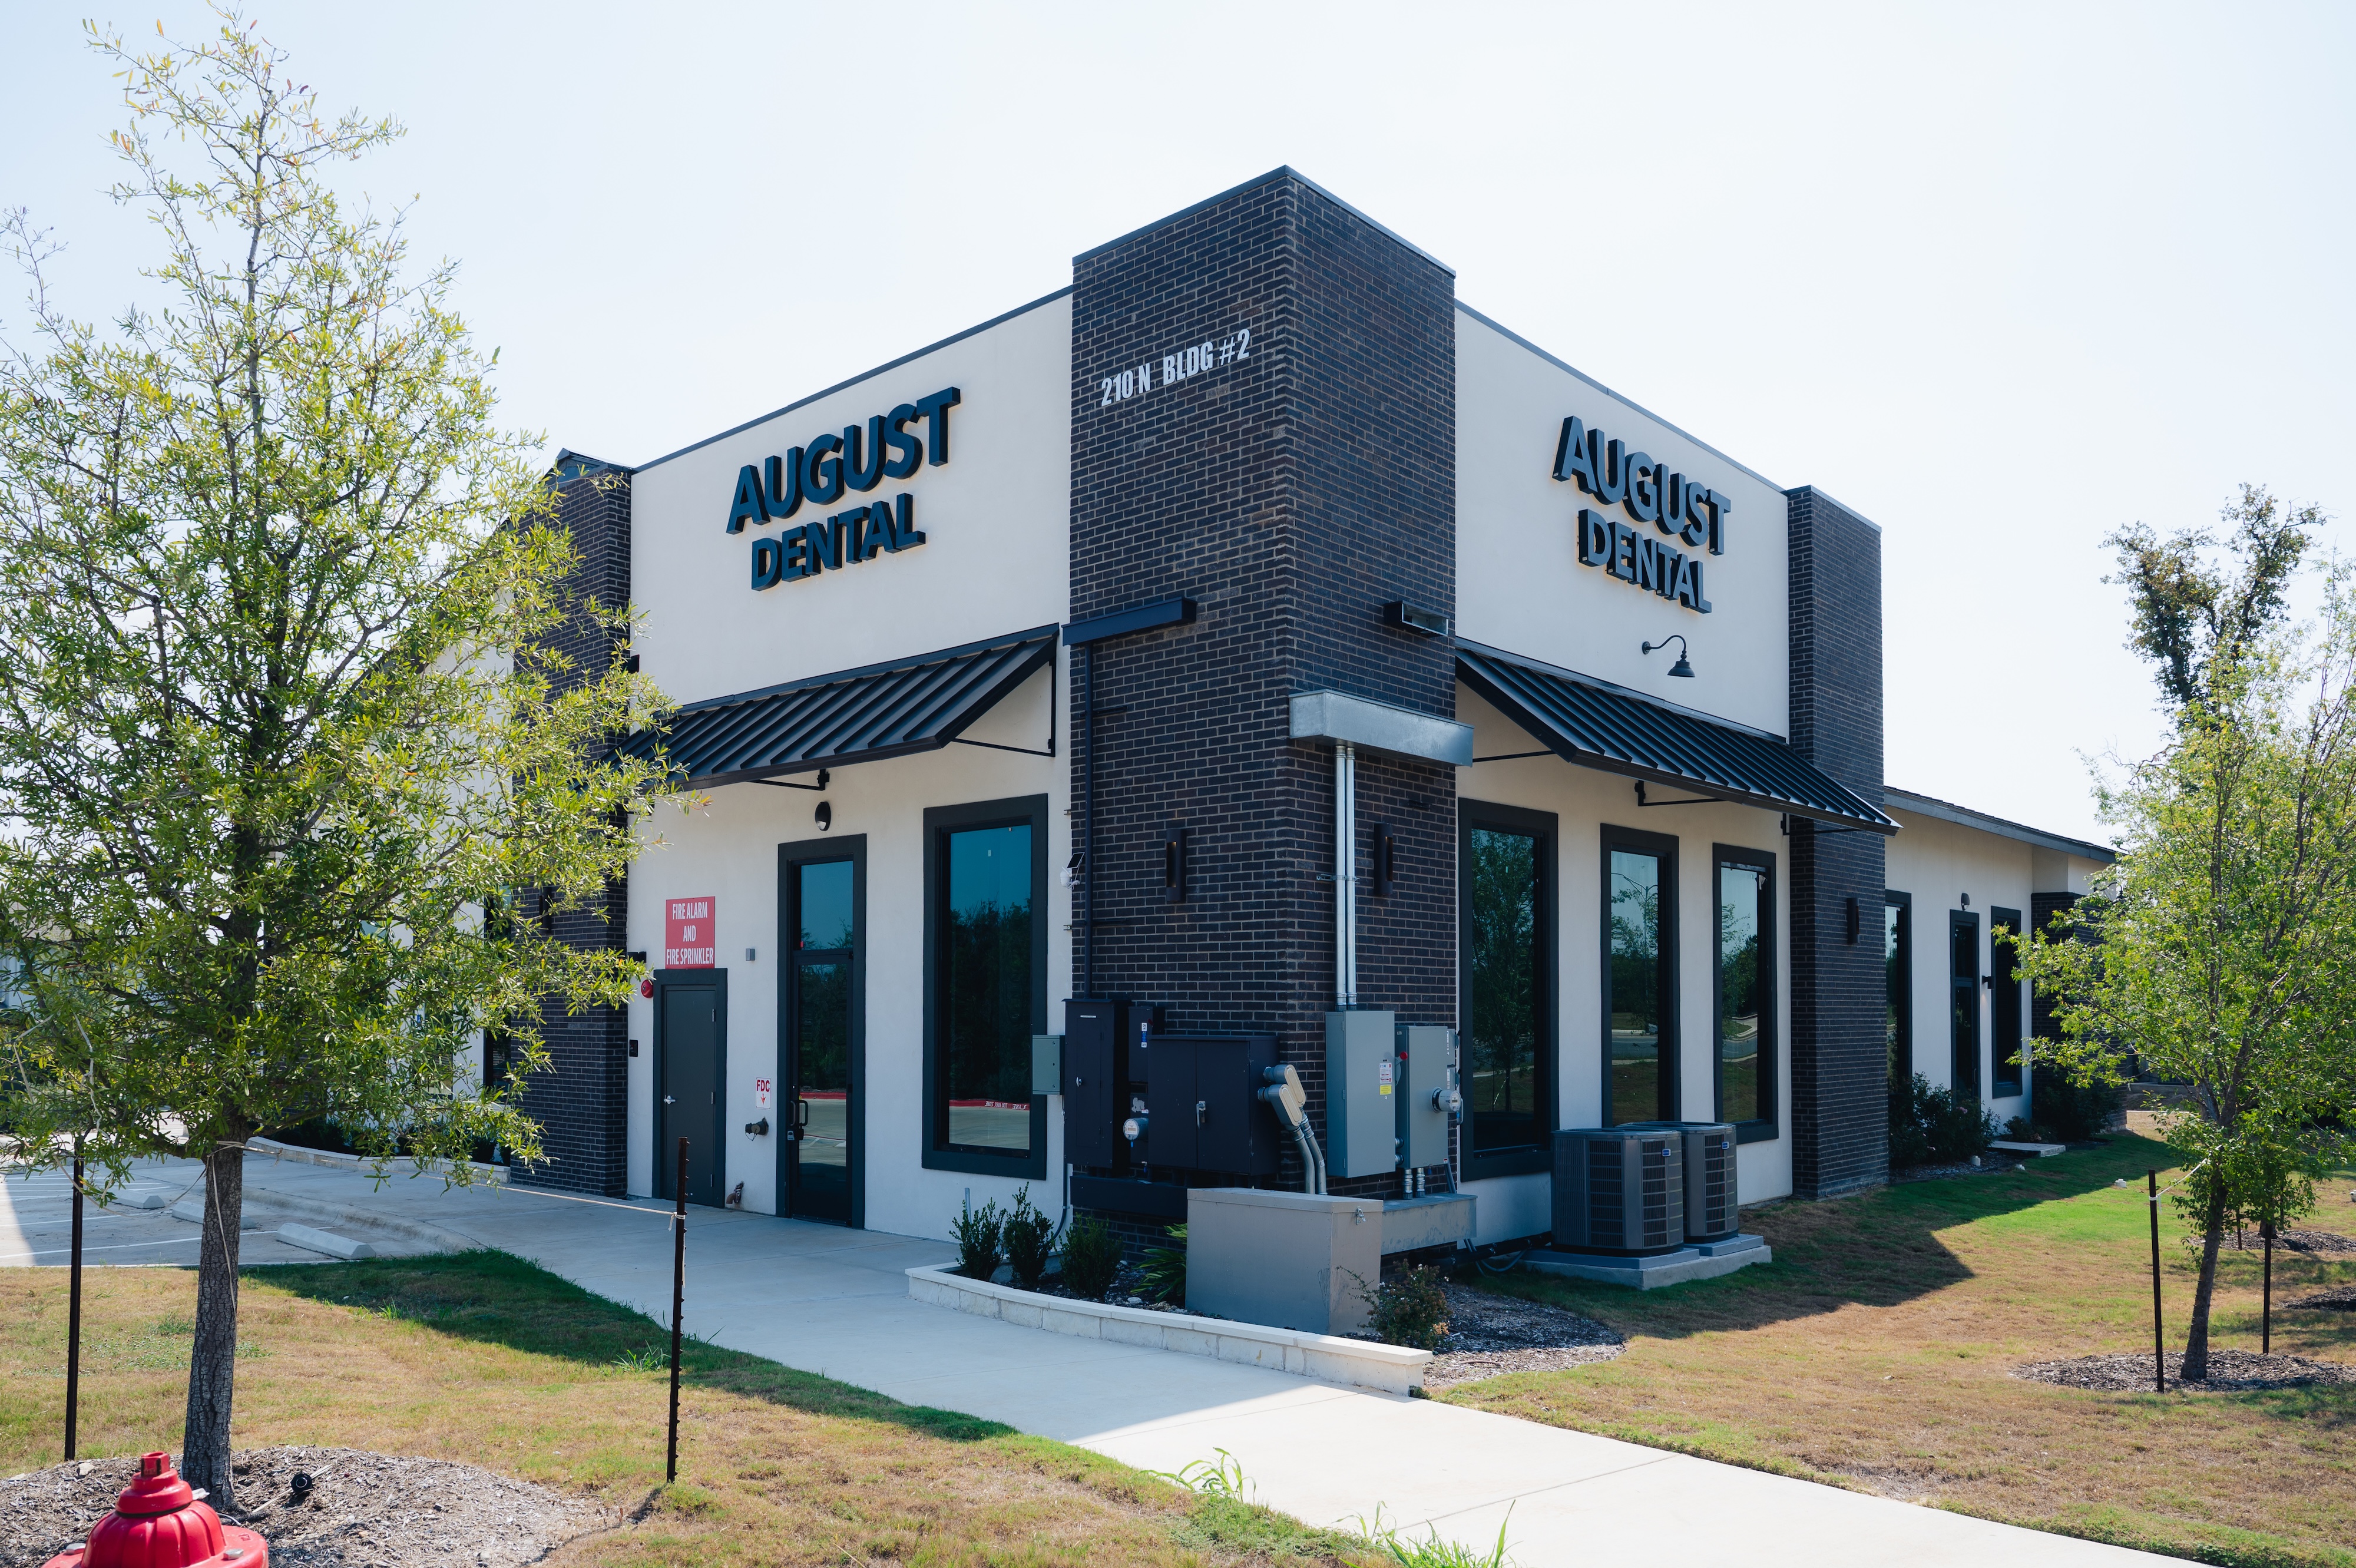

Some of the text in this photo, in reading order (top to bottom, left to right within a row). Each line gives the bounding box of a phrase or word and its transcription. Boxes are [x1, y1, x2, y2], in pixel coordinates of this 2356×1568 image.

[1101, 328, 1250, 406] 210 N BLDG #2
[726, 386, 961, 535] AUGUST
[1552, 415, 1731, 556] AUGUST
[751, 492, 926, 591] DENTAL
[1577, 508, 1712, 614] DENTAL
[672, 902, 707, 919] FIRE ALARM
[683, 925, 696, 942] AND
[666, 947, 714, 965] FIRE SPRINKLER
[756, 1079, 770, 1093] FDC
